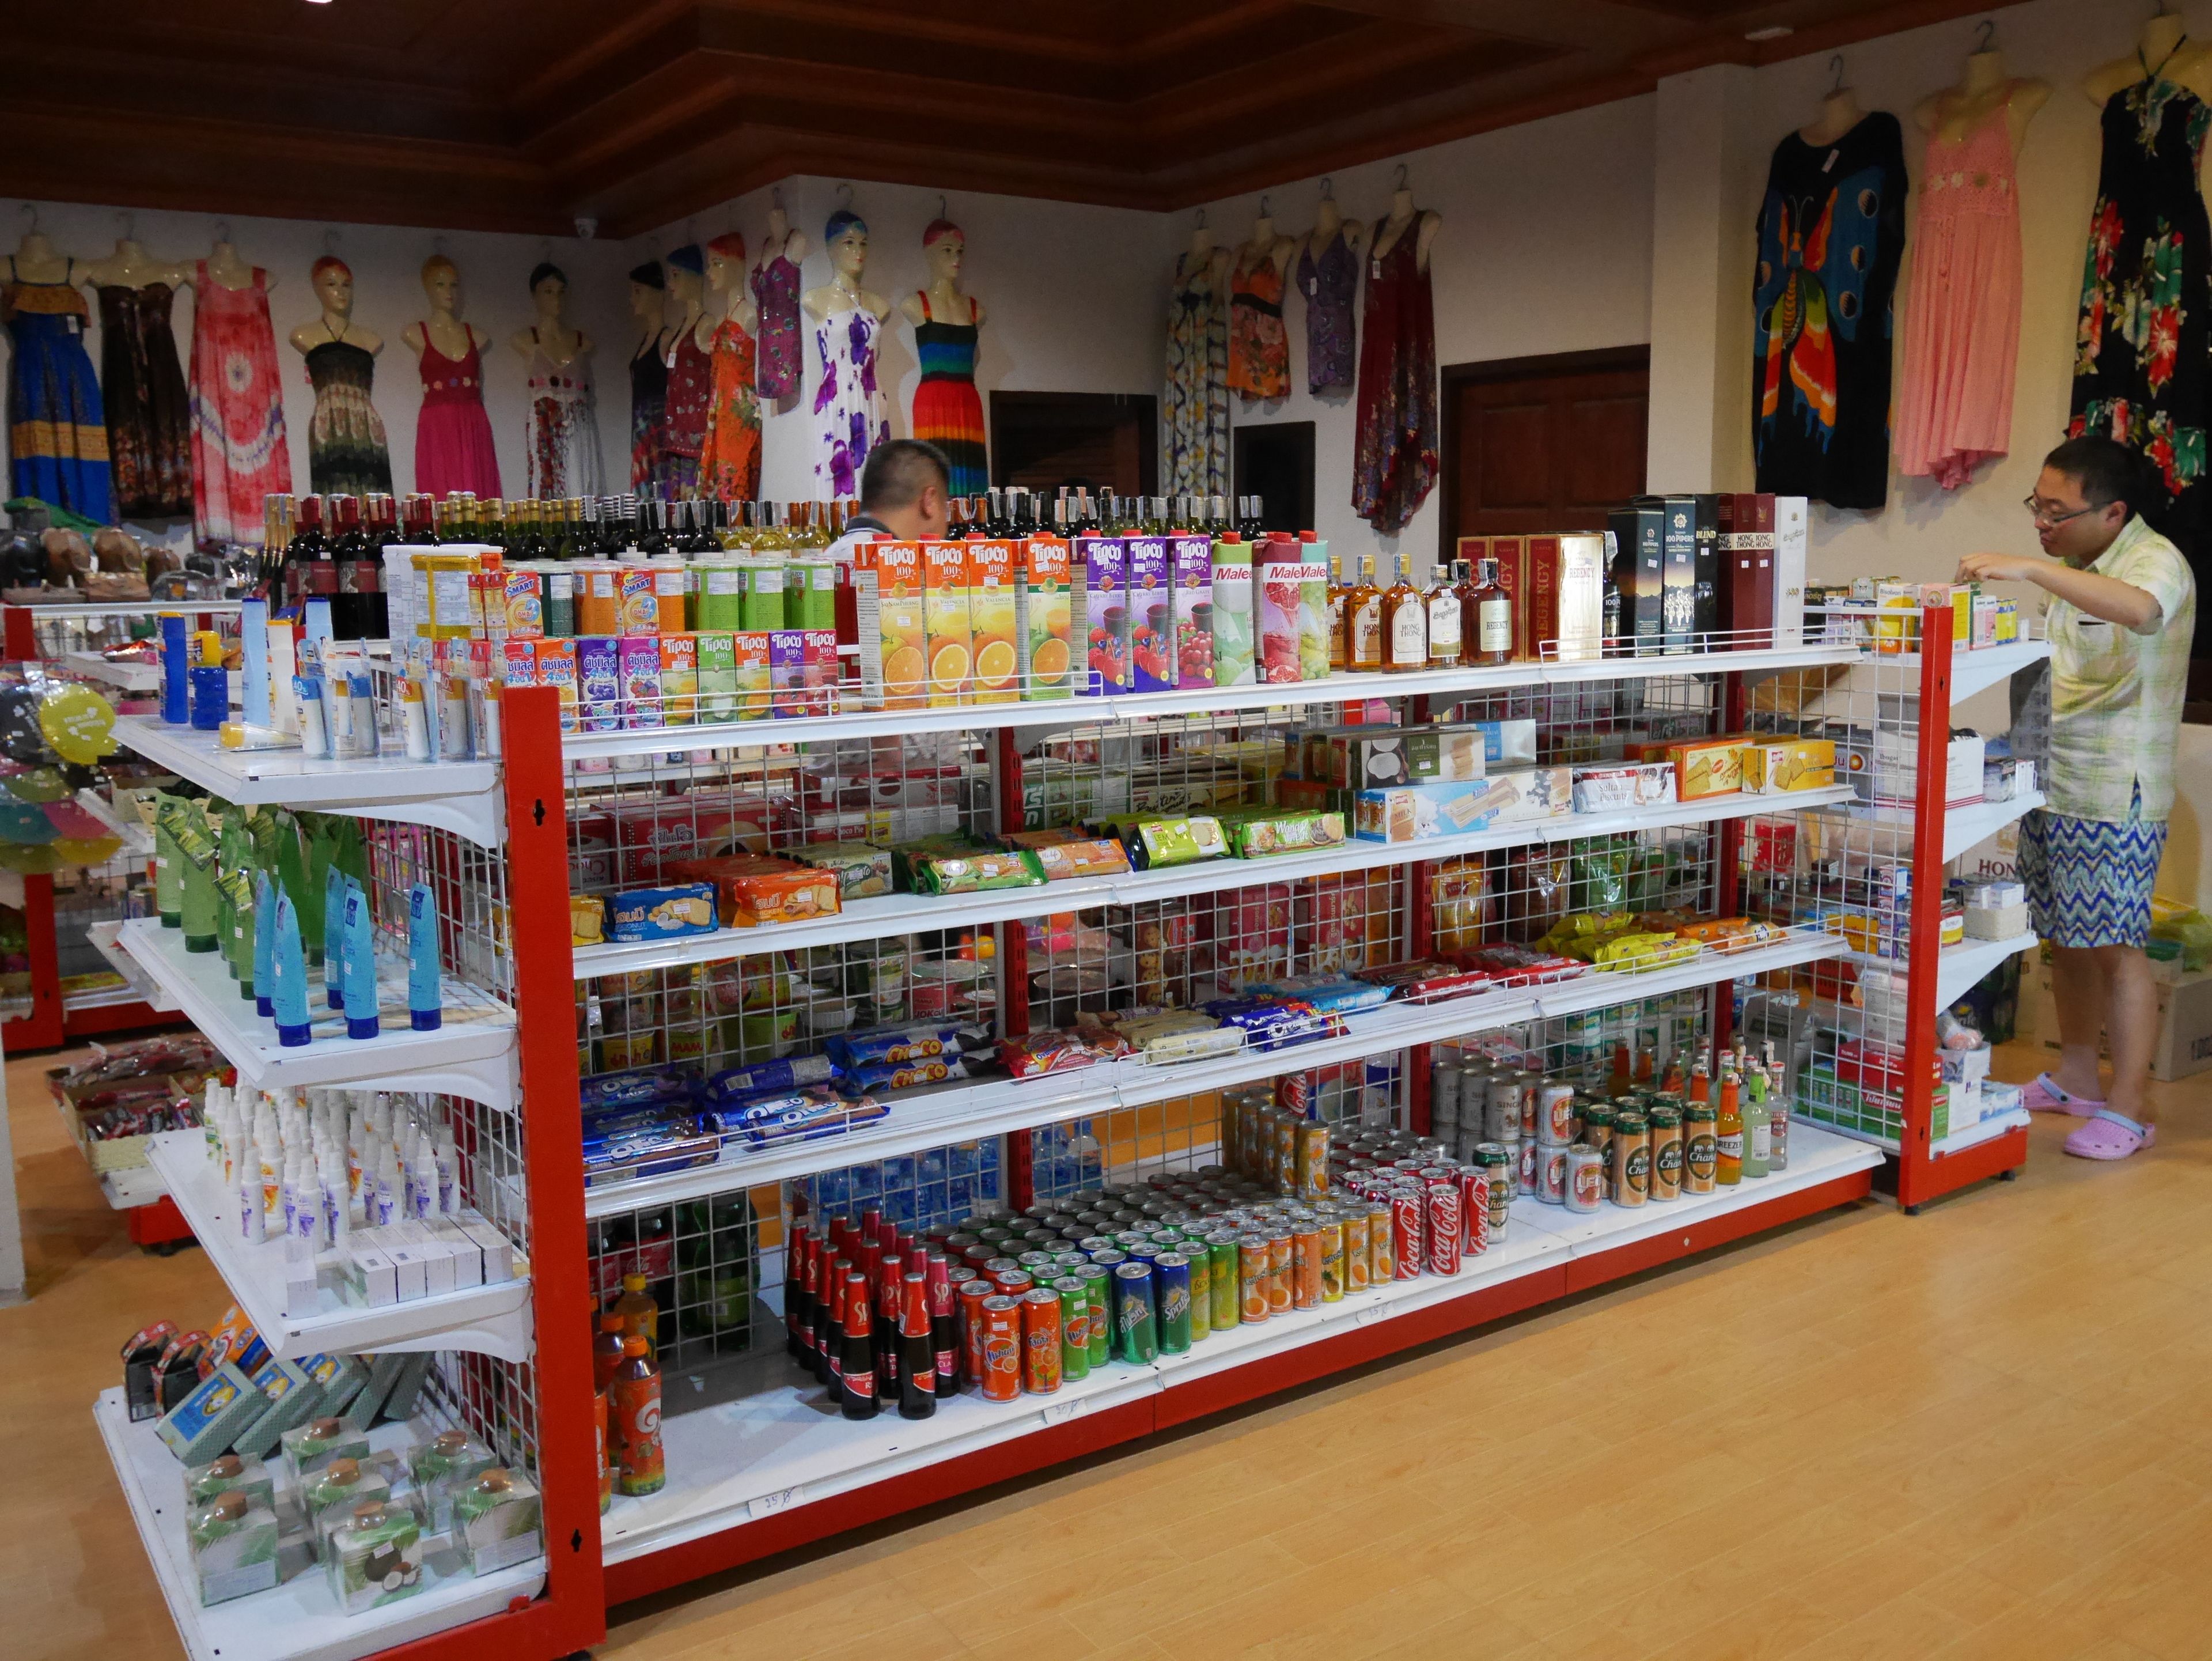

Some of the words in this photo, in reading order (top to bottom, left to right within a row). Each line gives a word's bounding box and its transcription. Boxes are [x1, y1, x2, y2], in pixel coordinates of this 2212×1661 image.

[1570, 567, 1594, 578] REGENCY
[509, 575, 527, 585] Ovaltine
[626, 574, 644, 584] Ovaltine
[506, 578, 534, 597] SMART
[623, 578, 652, 596] SMART
[1486, 621, 1508, 630] REGENCY
[854, 825, 864, 833] Pie
[1660, 1159, 1682, 1169] Chan
[1628, 1165, 1649, 1175] Chan
[1165, 1292, 1190, 1322] Sprite
[1028, 1336, 1049, 1348] Fanta
